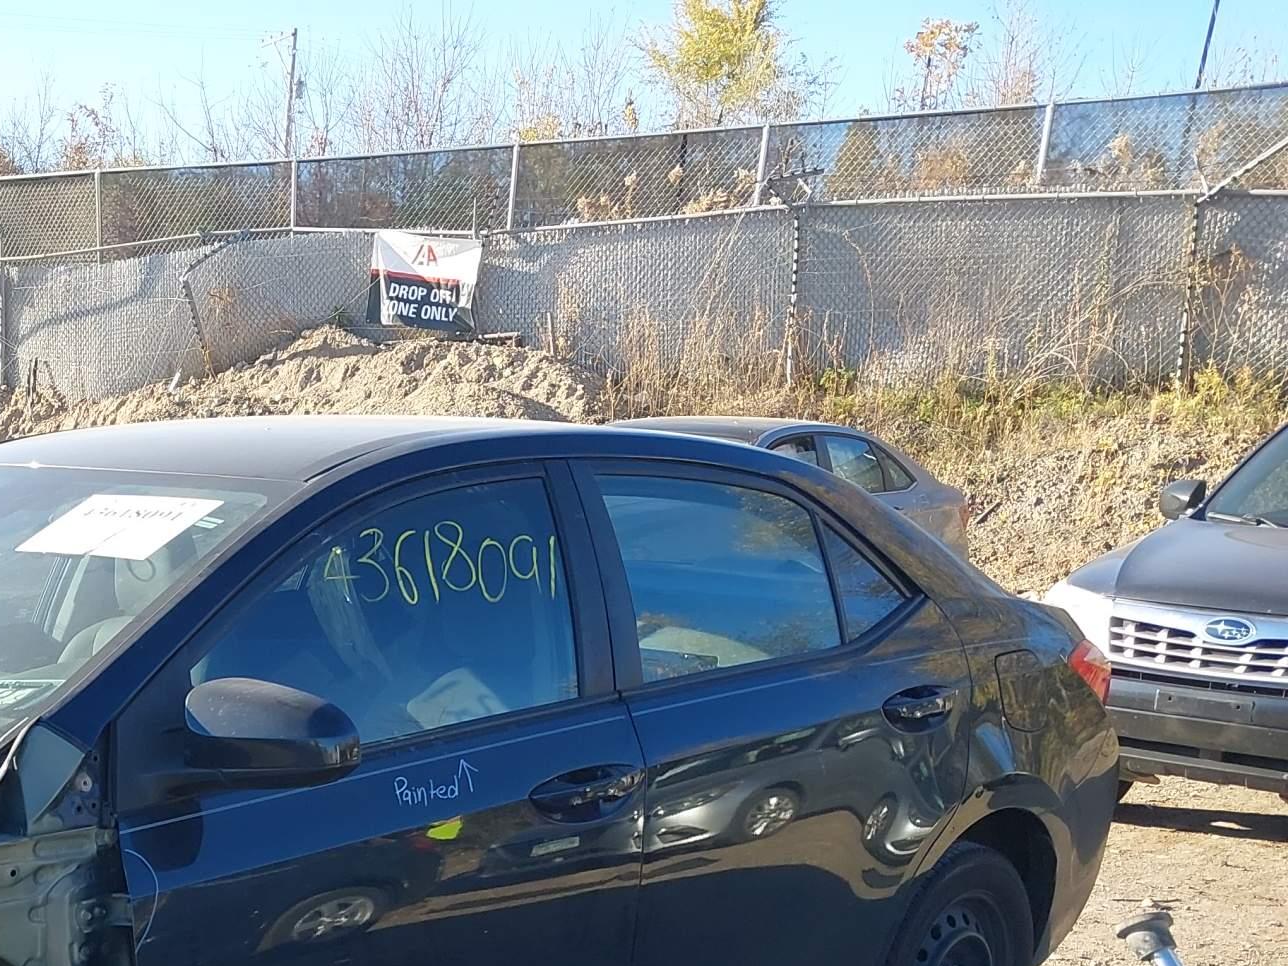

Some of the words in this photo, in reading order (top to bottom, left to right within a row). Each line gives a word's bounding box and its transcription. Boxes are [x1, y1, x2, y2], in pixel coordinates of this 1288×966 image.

[388, 282, 428, 301] DROP
[387, 300, 419, 318] ONE
[420, 304, 458, 322] ONLY
[323, 520, 556, 605] 43618091
[393, 774, 459, 807] Painted
